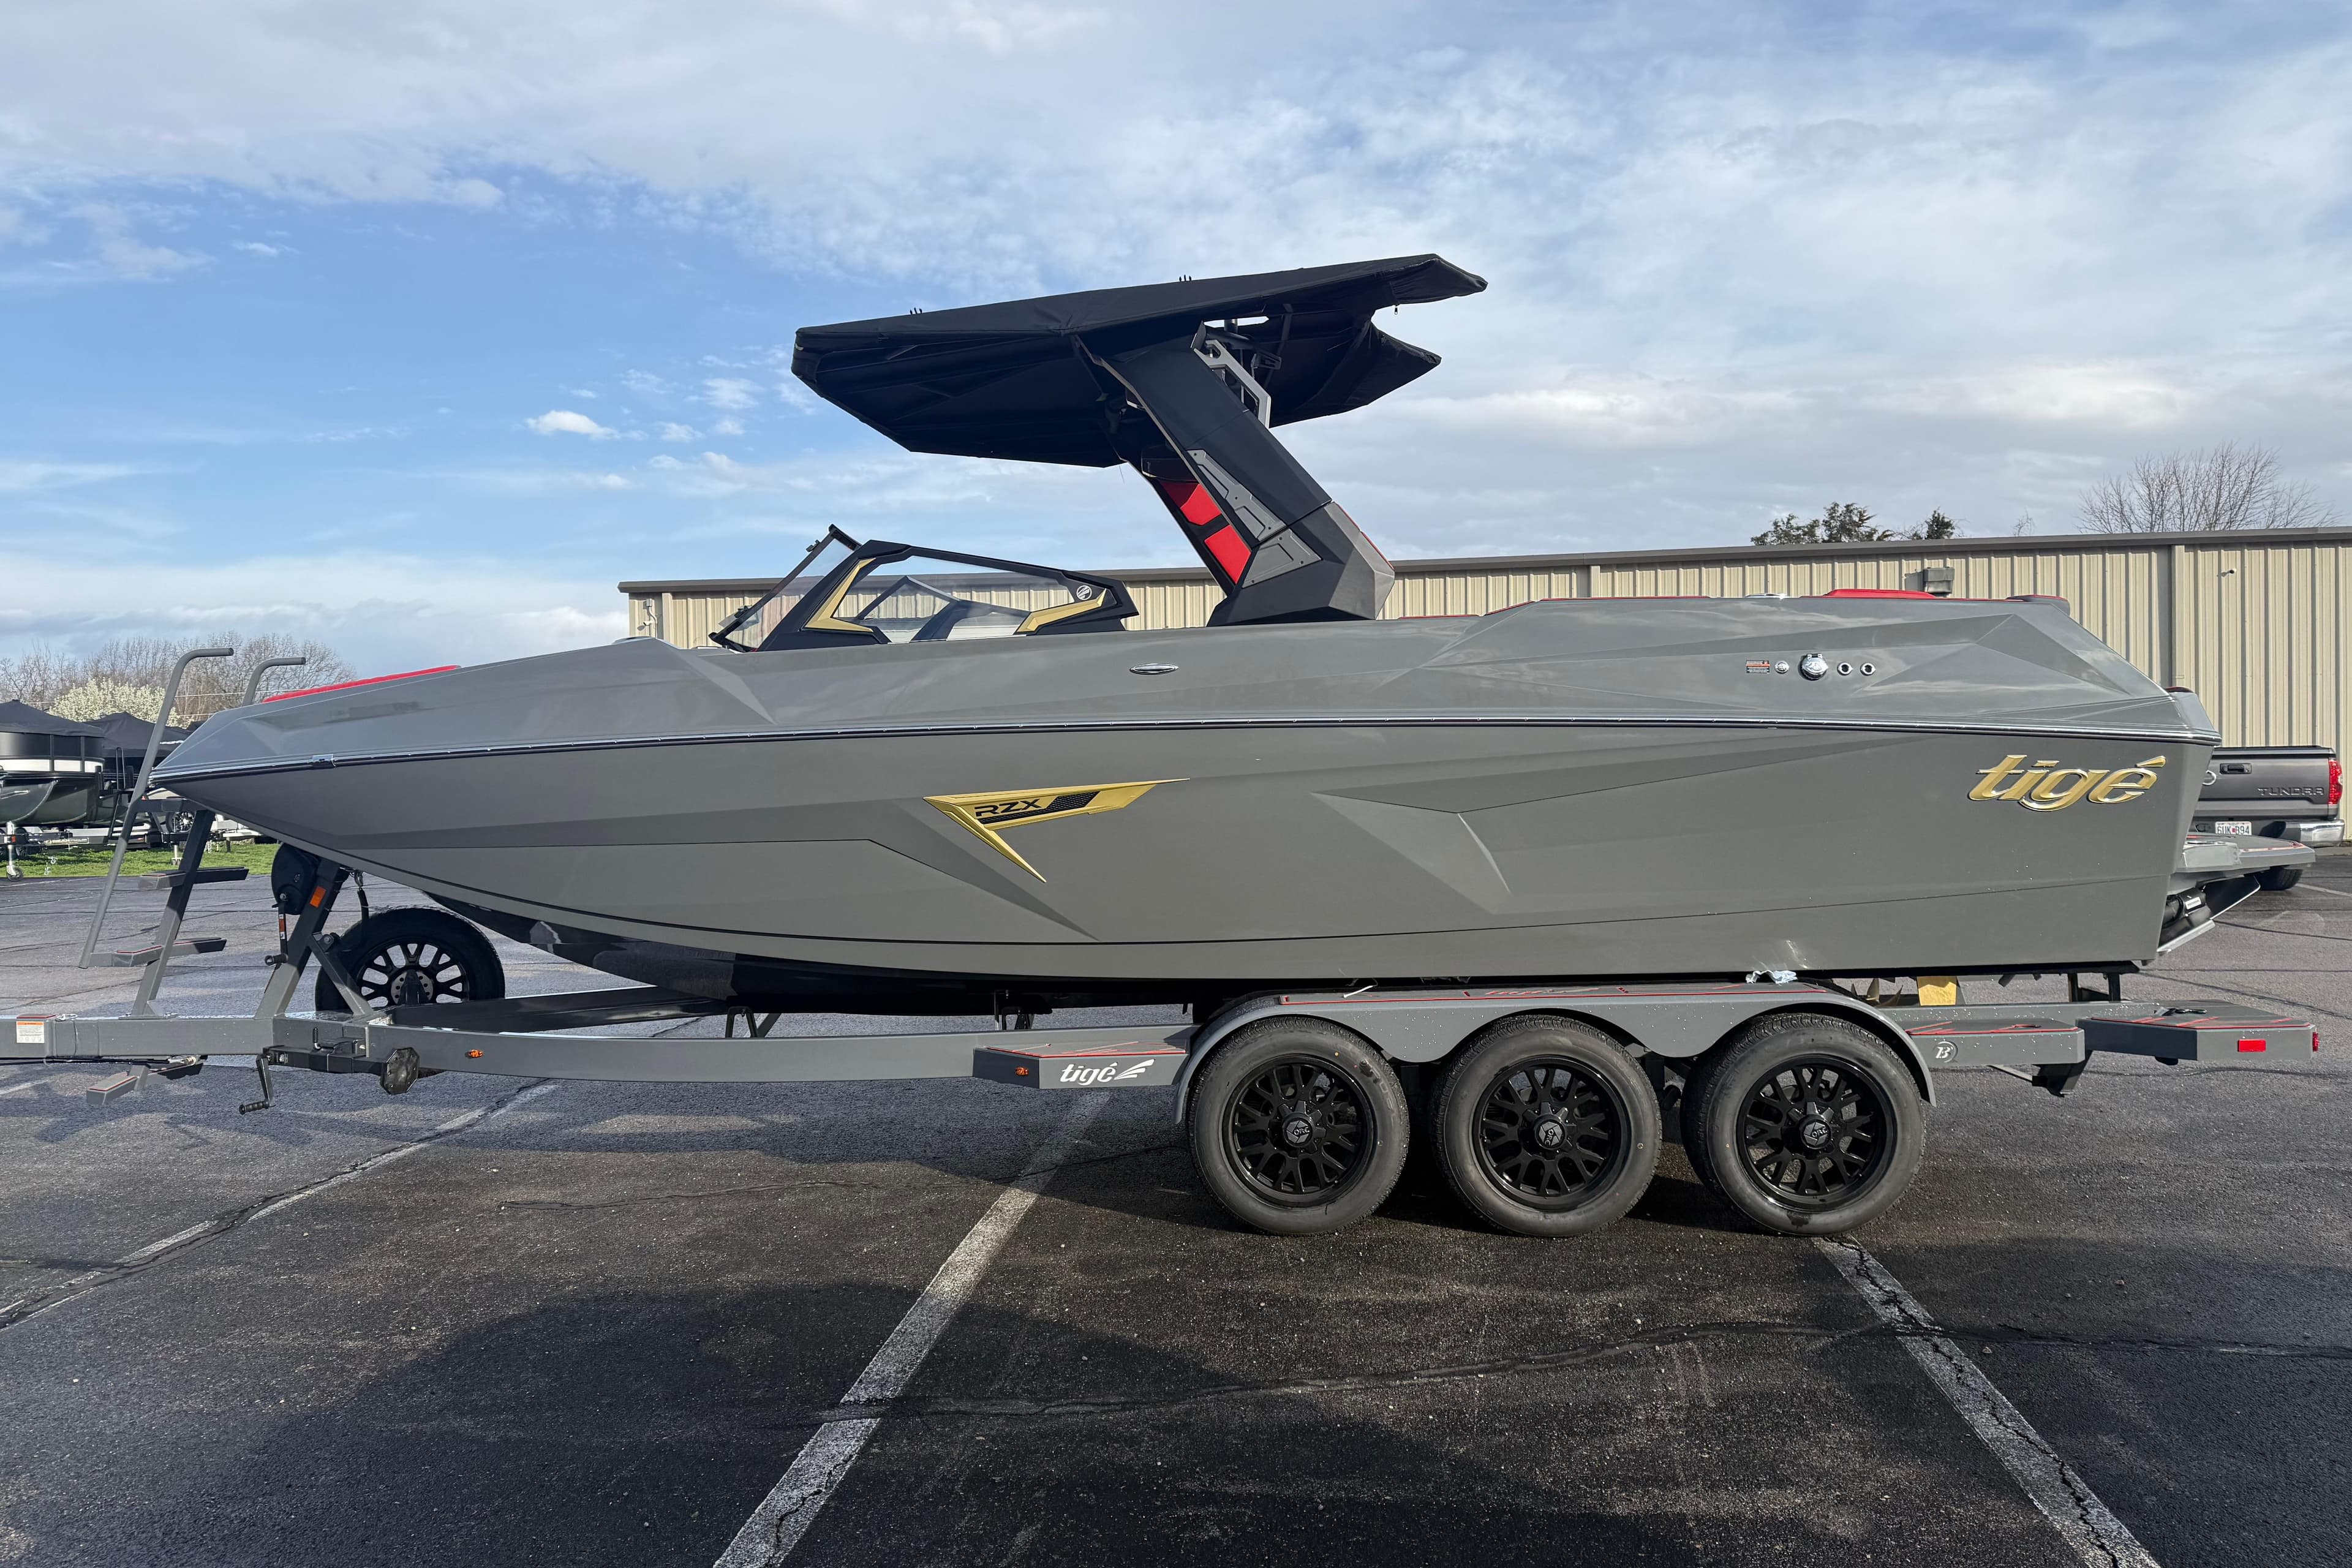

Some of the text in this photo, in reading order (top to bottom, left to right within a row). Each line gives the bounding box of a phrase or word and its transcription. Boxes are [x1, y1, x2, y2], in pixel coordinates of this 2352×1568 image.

[1968, 754, 2166, 812] tigé
[2256, 786, 2324, 796] TUNDRA
[974, 799, 1042, 816] RZX
[1060, 1061, 1118, 1086] tigé
